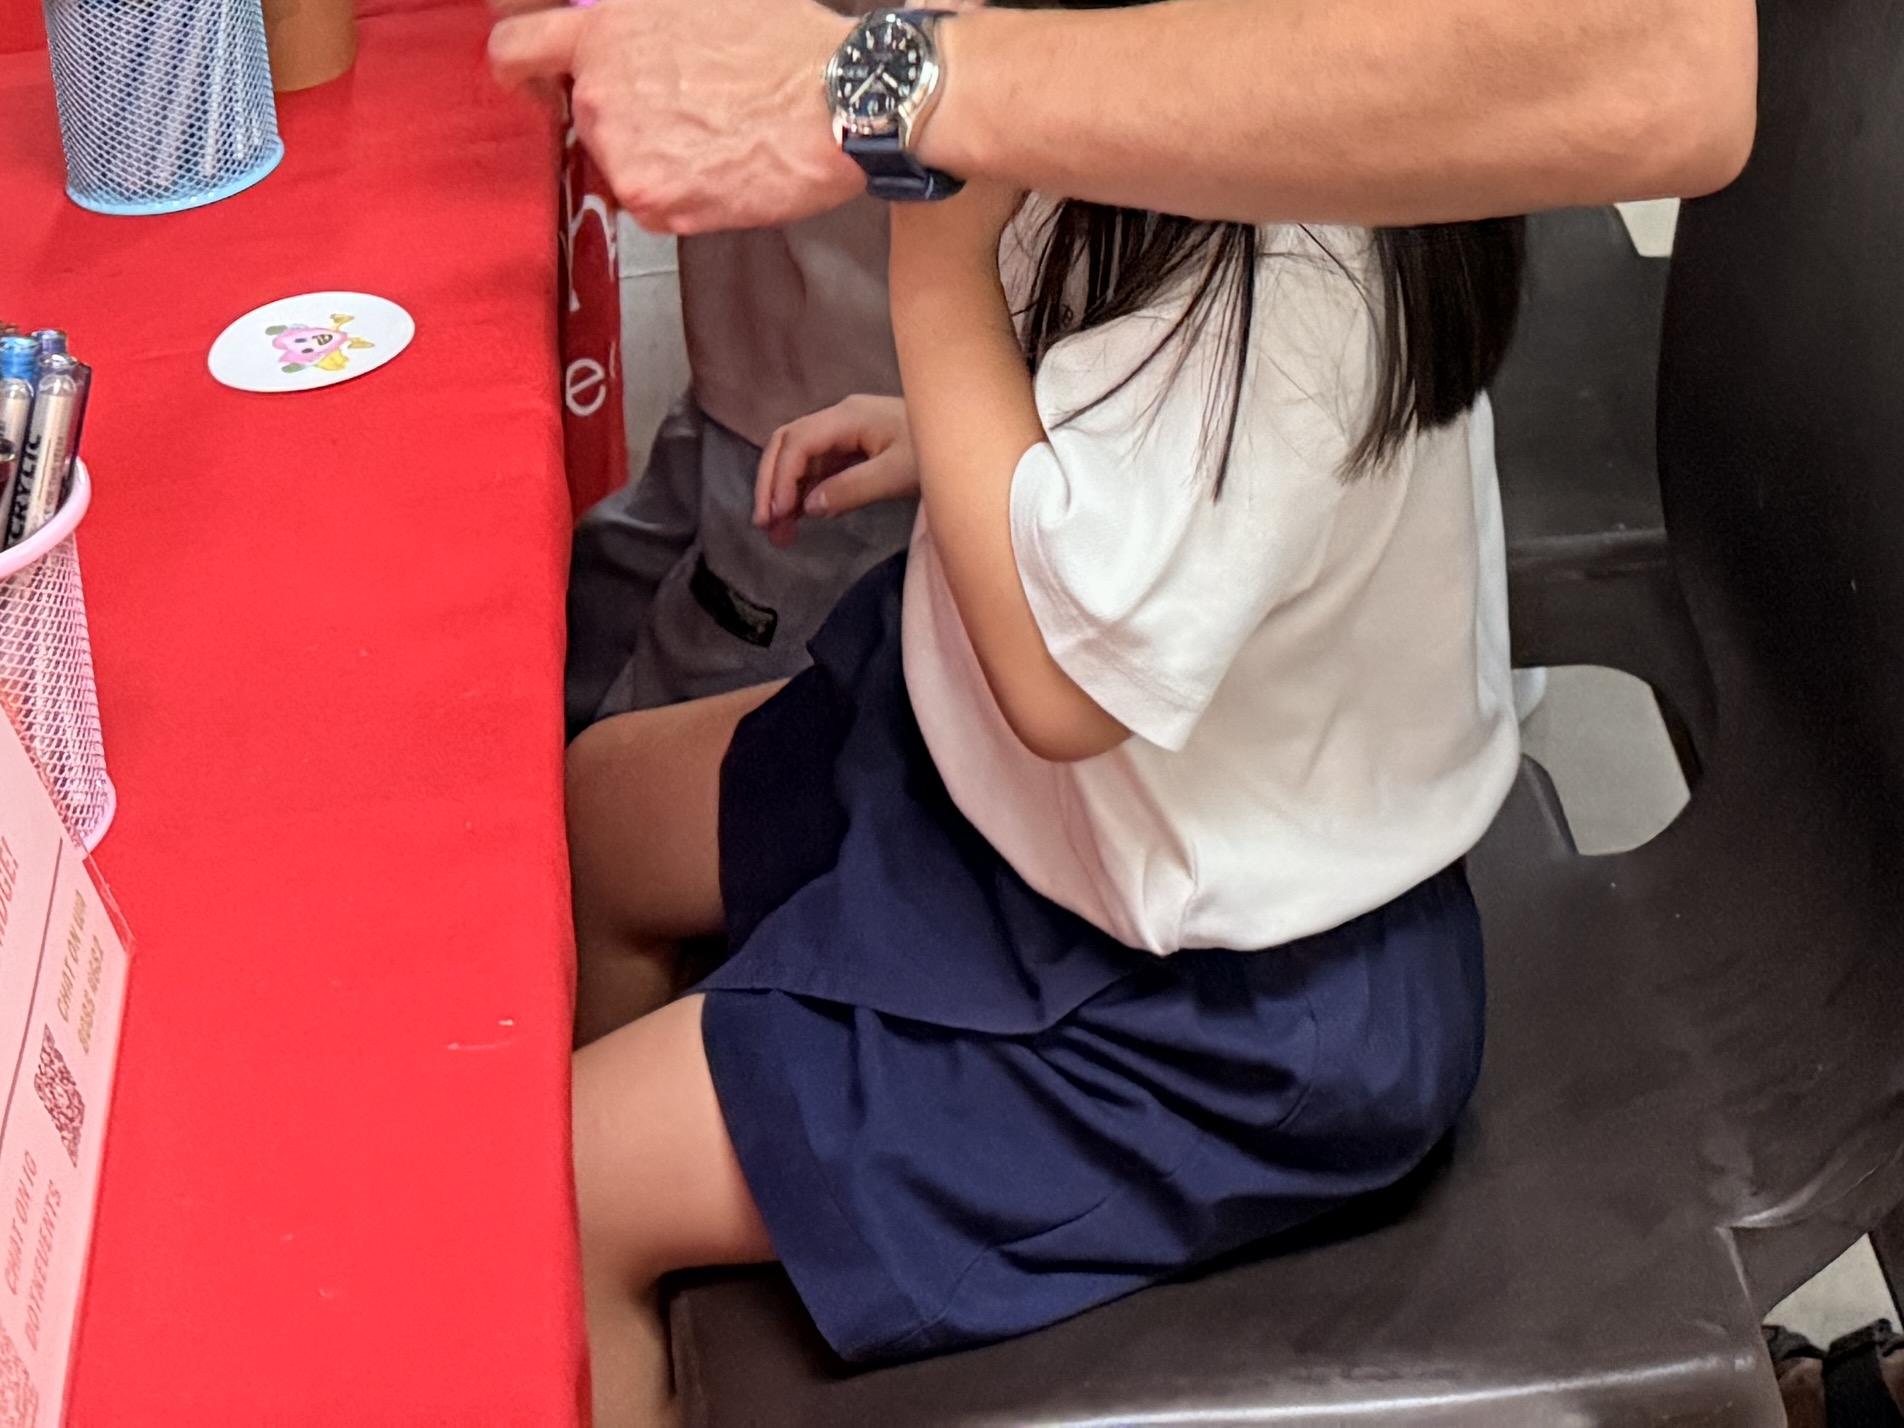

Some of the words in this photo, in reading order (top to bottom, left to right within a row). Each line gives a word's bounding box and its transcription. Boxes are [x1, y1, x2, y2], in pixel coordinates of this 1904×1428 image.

[9, 434, 42, 541] CRYLIC
[4, 1217, 24, 1296] CHAT
[15, 1179, 32, 1224] ON
